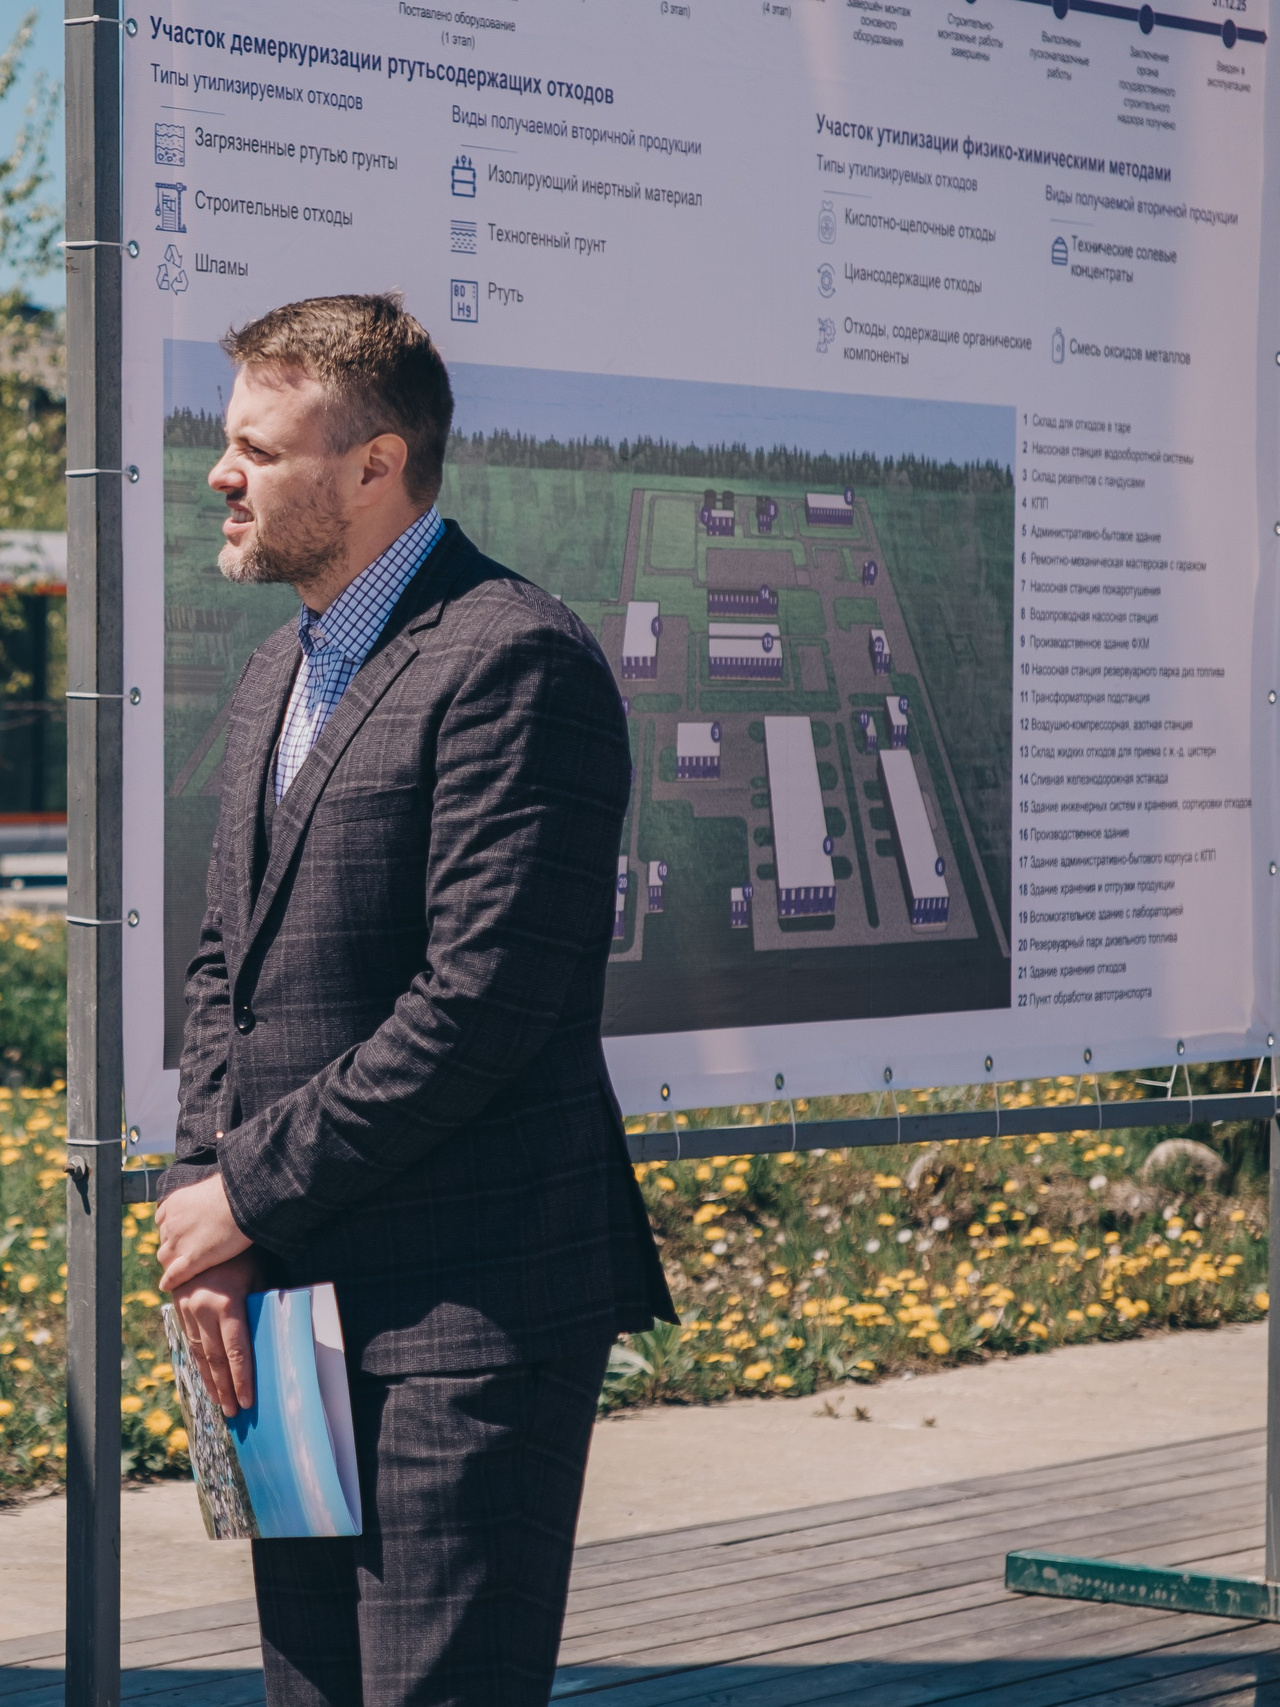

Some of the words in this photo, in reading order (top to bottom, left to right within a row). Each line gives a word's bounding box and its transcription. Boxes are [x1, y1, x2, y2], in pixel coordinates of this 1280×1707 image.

[399, 2, 452, 21] Поставлено
[455, 12, 515, 32] оборудование
[670, 5, 690, 18] этап)
[772, 6, 791, 19] этап)
[453, 35, 475, 50] этап)
[150, 16, 225, 49] Участок
[230, 34, 381, 72] демеркуризации
[388, 57, 541, 95] ртутьсодержащих
[547, 80, 613, 105] отходов
[151, 63, 188, 86] Типы
[194, 74, 303, 102] утилизируемых
[308, 90, 362, 111] отходов
[453, 105, 486, 128] Виды
[492, 115, 567, 137] получаемой
[572, 126, 635, 145] вторичной
[640, 135, 701, 155] продукции
[195, 127, 295, 157] Загрязненные
[300, 145, 347, 165] ртутью
[352, 152, 397, 171] грунты
[817, 113, 873, 140] Участок
[878, 128, 958, 154] утилизации
[963, 136, 1105, 172] физико-химическими
[1110, 161, 1171, 182] методами
[489, 164, 578, 192] Изолирующий
[582, 180, 641, 199] инертный
[645, 188, 702, 207] материал
[817, 154, 845, 173] Типы
[849, 163, 932, 185] утилизируемых
[936, 174, 977, 192] отходов
[195, 190, 298, 219] Строительные
[303, 207, 352, 227] отходы
[1046, 185, 1072, 204] Виды
[1076, 193, 1134, 211] получаемой
[1138, 201, 1187, 218] вторичной
[1190, 208, 1238, 226] продукции
[488, 223, 570, 248] Техногенный
[575, 237, 606, 256] грунт
[845, 208, 955, 237] Кислотно-щелочные
[959, 226, 996, 243] отходы
[196, 253, 248, 276] Шламы
[1072, 235, 1133, 258] Технические
[1136, 247, 1177, 263] солевые
[845, 263, 941, 289] Циансодержащие
[944, 278, 982, 294] отходы
[1071, 265, 1133, 283] концентраты
[454, 284, 465, 297] 80
[488, 282, 523, 306] Ртуть
[457, 302, 471, 318] Hg
[844, 317, 889, 339] Отходы,
[893, 326, 960, 344] содержащие
[963, 332, 1032, 350] органические
[844, 348, 909, 364] компоненты
[1070, 338, 1101, 357] Смесь
[1104, 345, 1142, 361] оксидов
[1145, 350, 1190, 365] металлов
